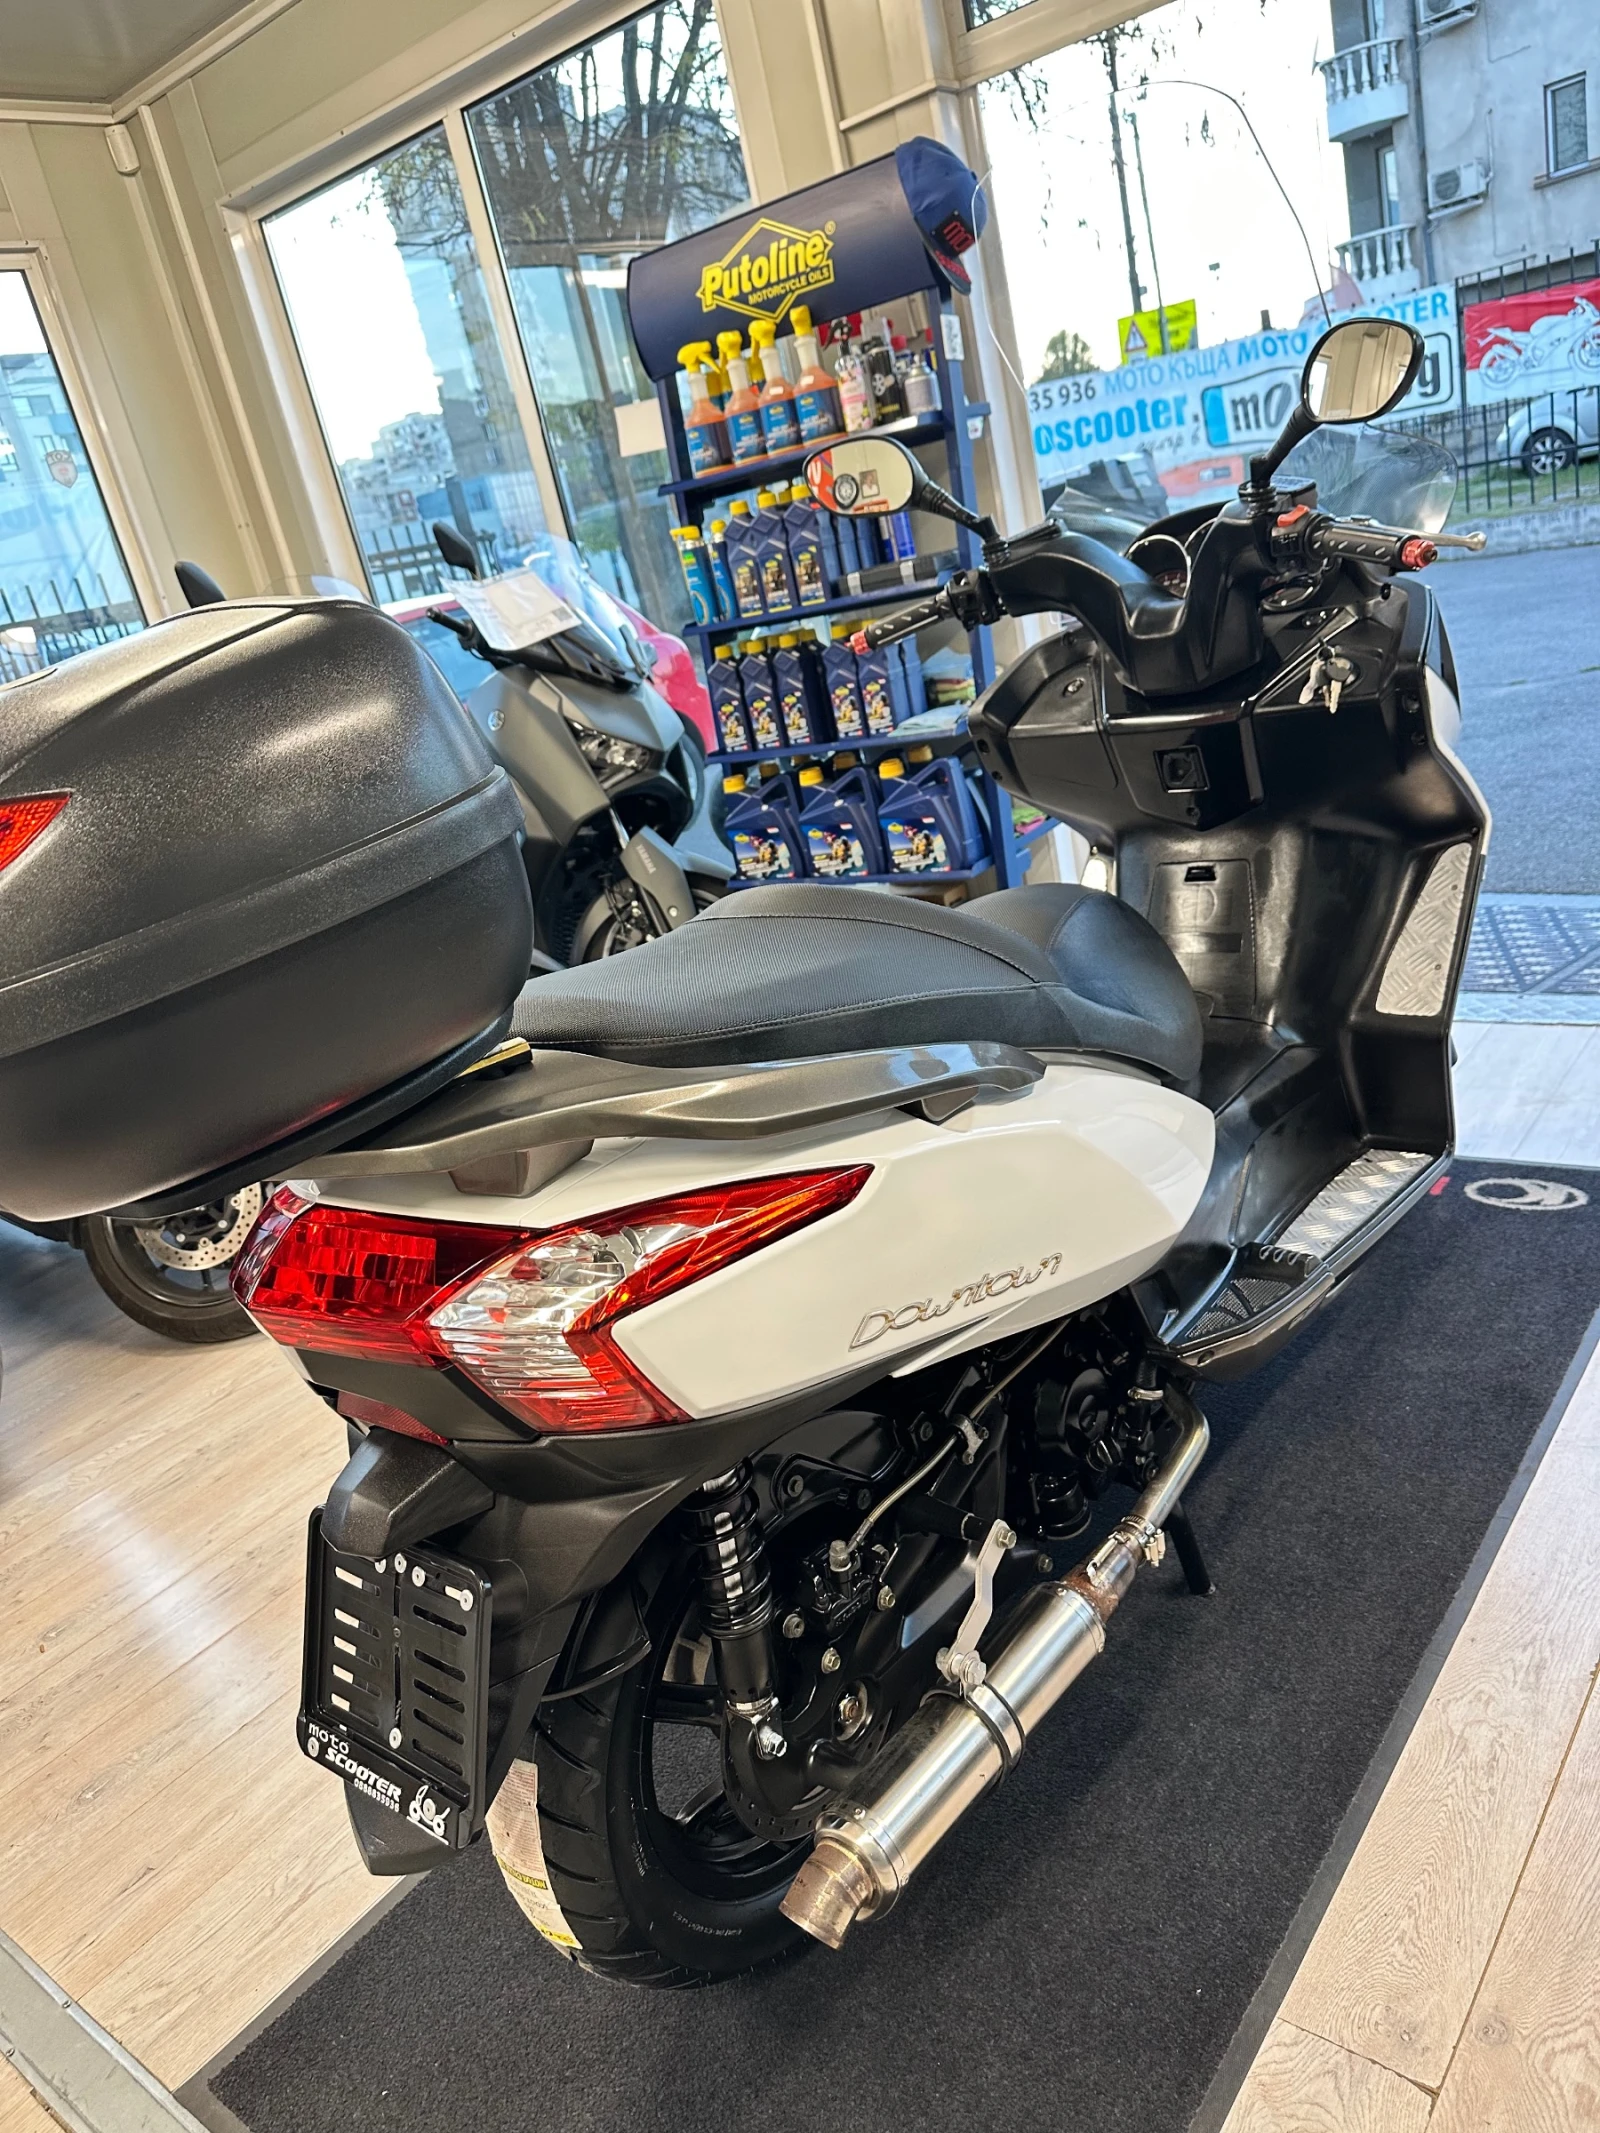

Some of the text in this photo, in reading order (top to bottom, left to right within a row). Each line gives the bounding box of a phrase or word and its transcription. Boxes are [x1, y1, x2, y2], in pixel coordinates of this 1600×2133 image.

[704, 233, 825, 306] Putoline
[748, 266, 829, 305] MOTORCYCLE OILS
[1059, 378, 1096, 406] 936
[1169, 348, 1230, 381] КЪЩА
[848, 1252, 1062, 1352] Downtown
[308, 1722, 349, 1755] moto
[325, 1746, 402, 1802] SCOOTER
